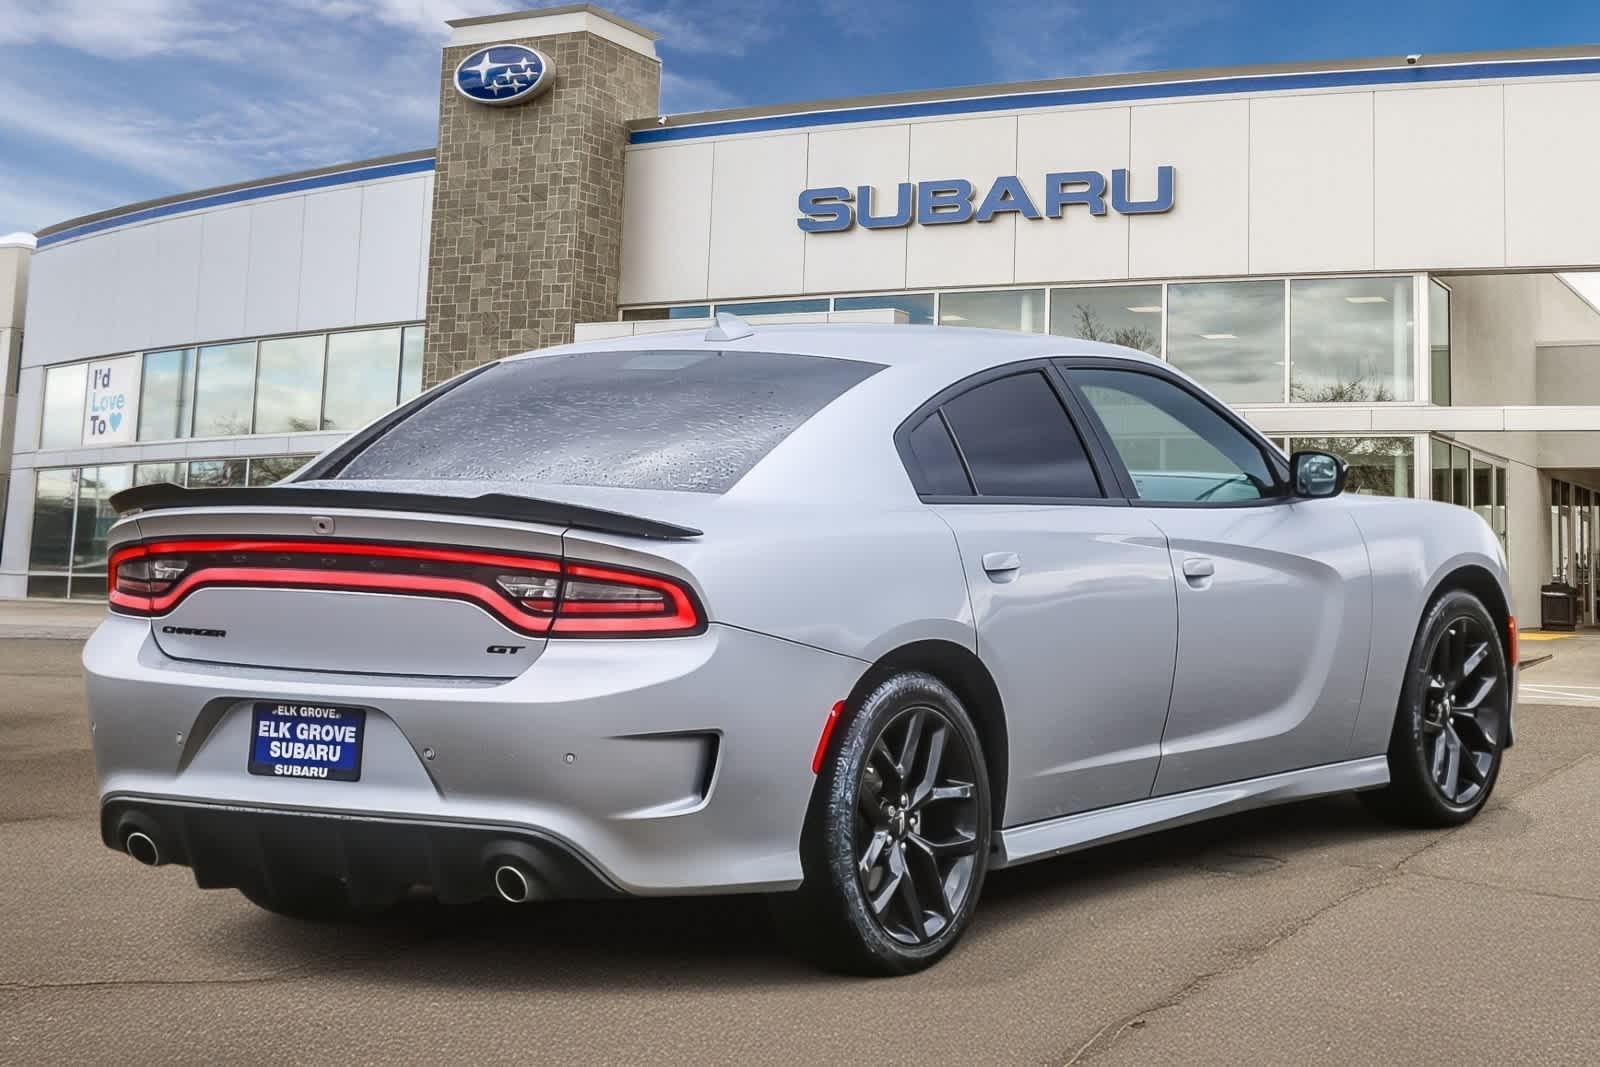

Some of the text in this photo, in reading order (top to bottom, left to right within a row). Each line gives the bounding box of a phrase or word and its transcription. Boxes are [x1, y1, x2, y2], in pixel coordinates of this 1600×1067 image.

[797, 165, 1175, 233] SUBARU
[94, 368, 111, 389] I'd
[91, 392, 125, 412] Love
[90, 415, 106, 436] To
[486, 645, 526, 654] GT
[277, 705, 336, 719] ELK GROVE
[258, 720, 357, 743] ELK GROVE
[269, 741, 341, 762] SUBARU
[274, 764, 328, 778] SUBARU
